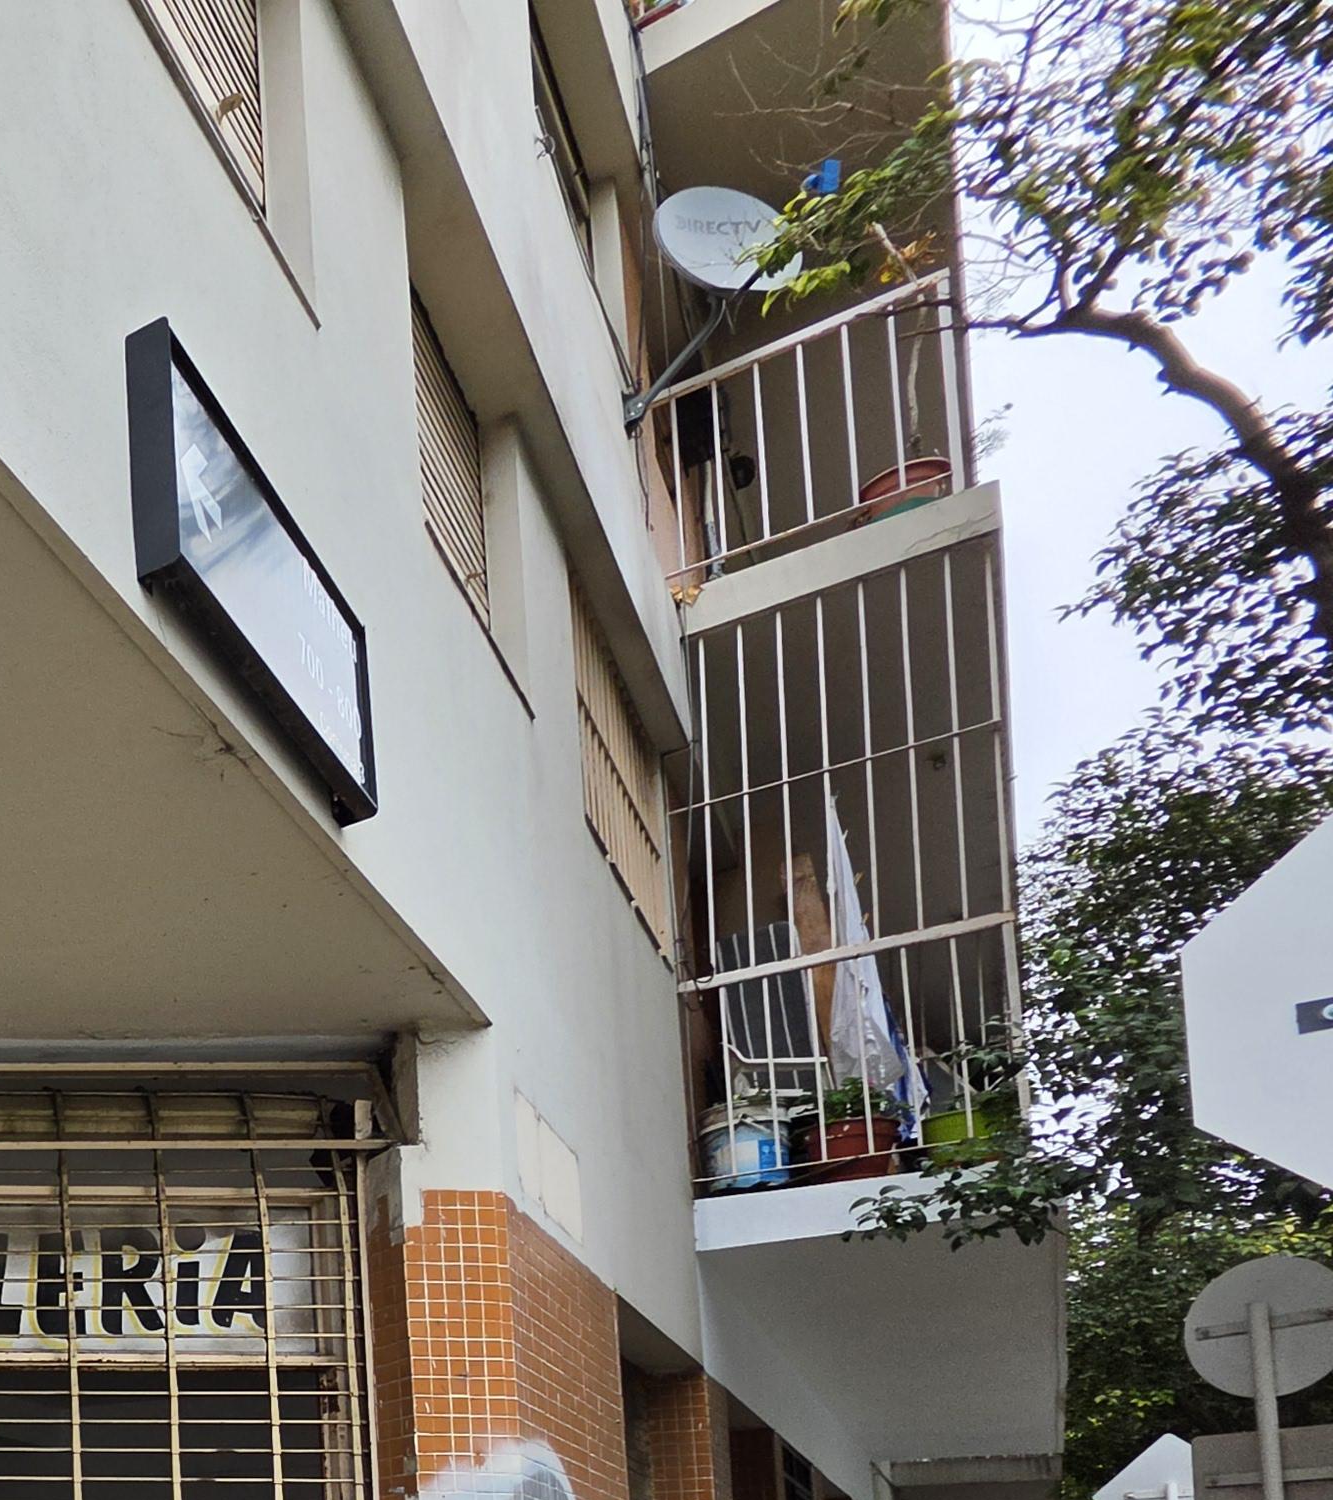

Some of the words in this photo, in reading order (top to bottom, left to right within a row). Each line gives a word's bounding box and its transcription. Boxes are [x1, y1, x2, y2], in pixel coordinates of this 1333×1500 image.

[675, 214, 762, 236] DIRECTV
[298, 632, 324, 690] 700
[336, 686, 362, 740] 800
